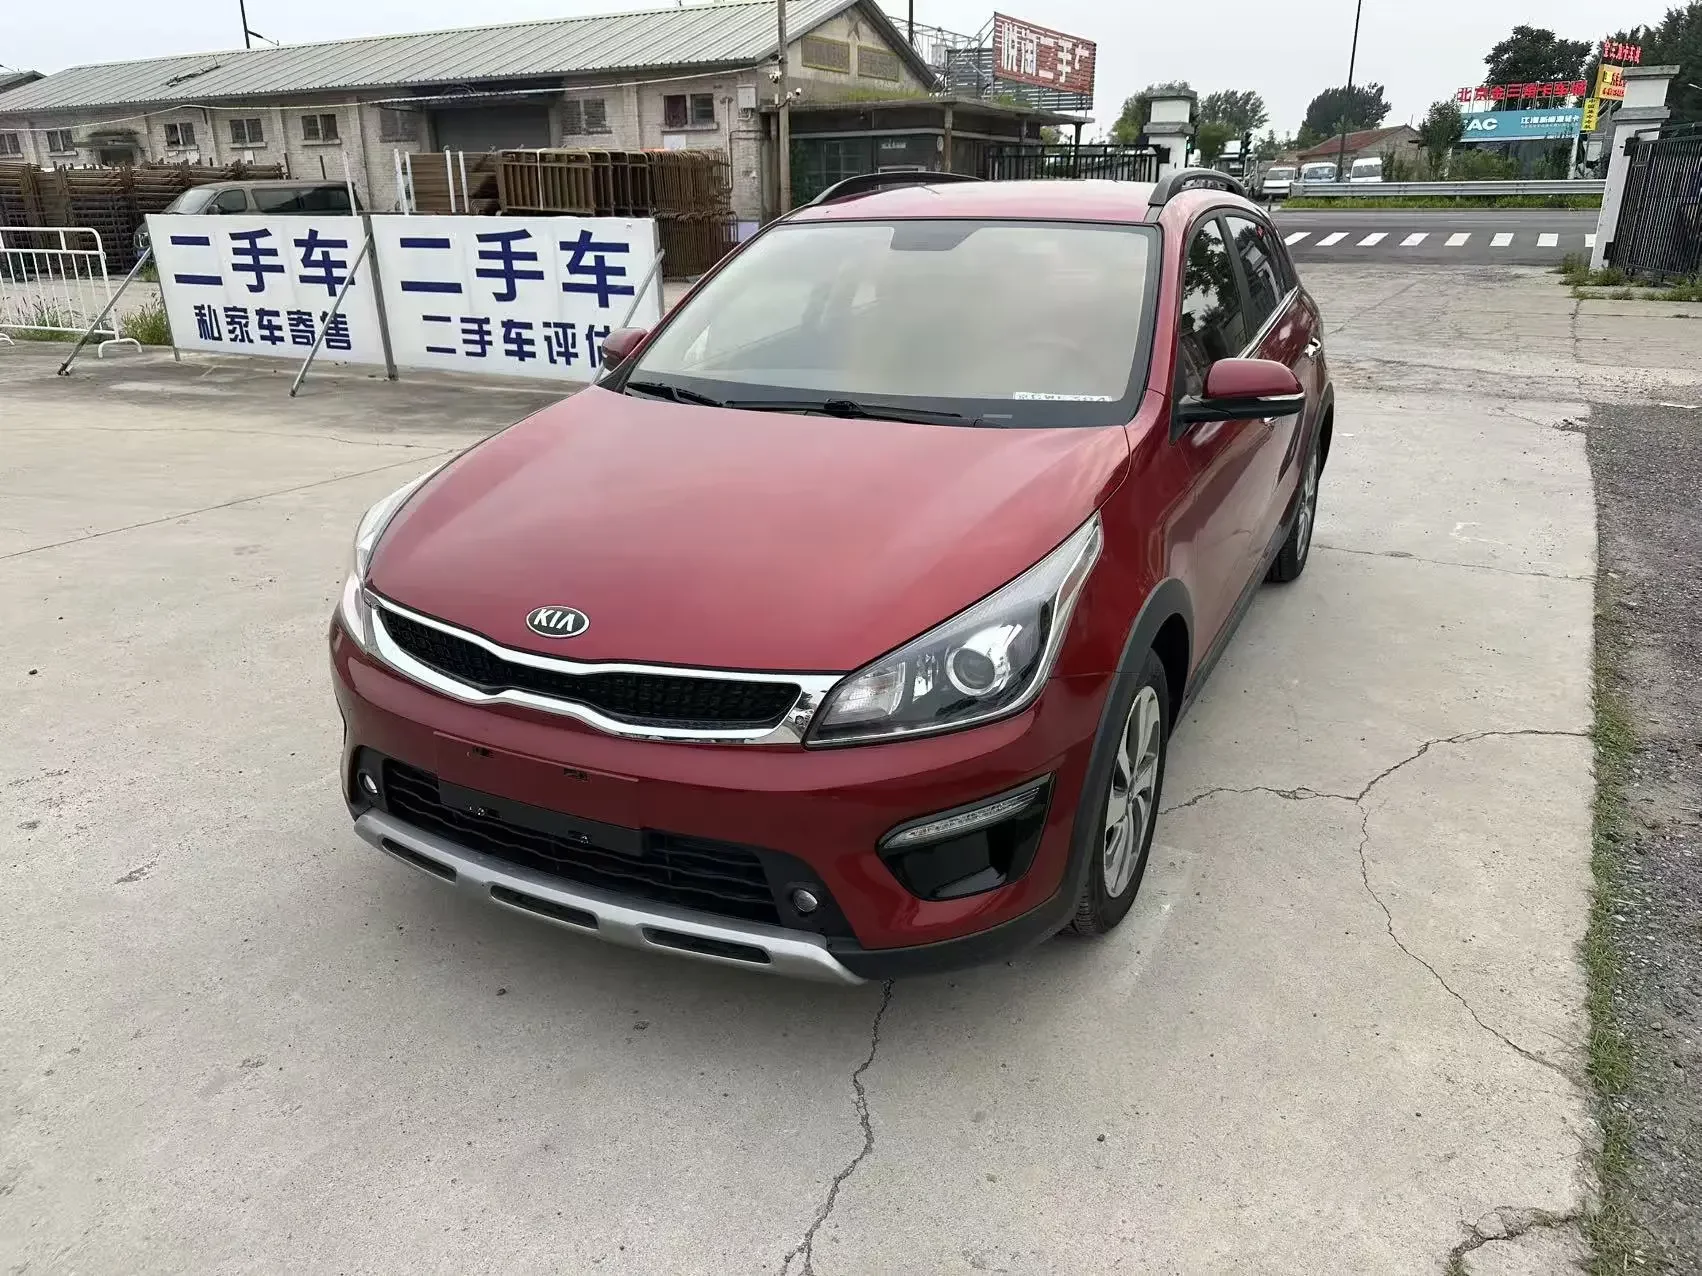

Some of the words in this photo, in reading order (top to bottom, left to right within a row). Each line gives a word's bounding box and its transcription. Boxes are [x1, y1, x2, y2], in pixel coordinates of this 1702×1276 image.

[170, 228, 356, 298] 二手车
[399, 228, 635, 309] 二手车
[193, 303, 352, 351] 私家车寄售
[533, 608, 575, 631] KIA
